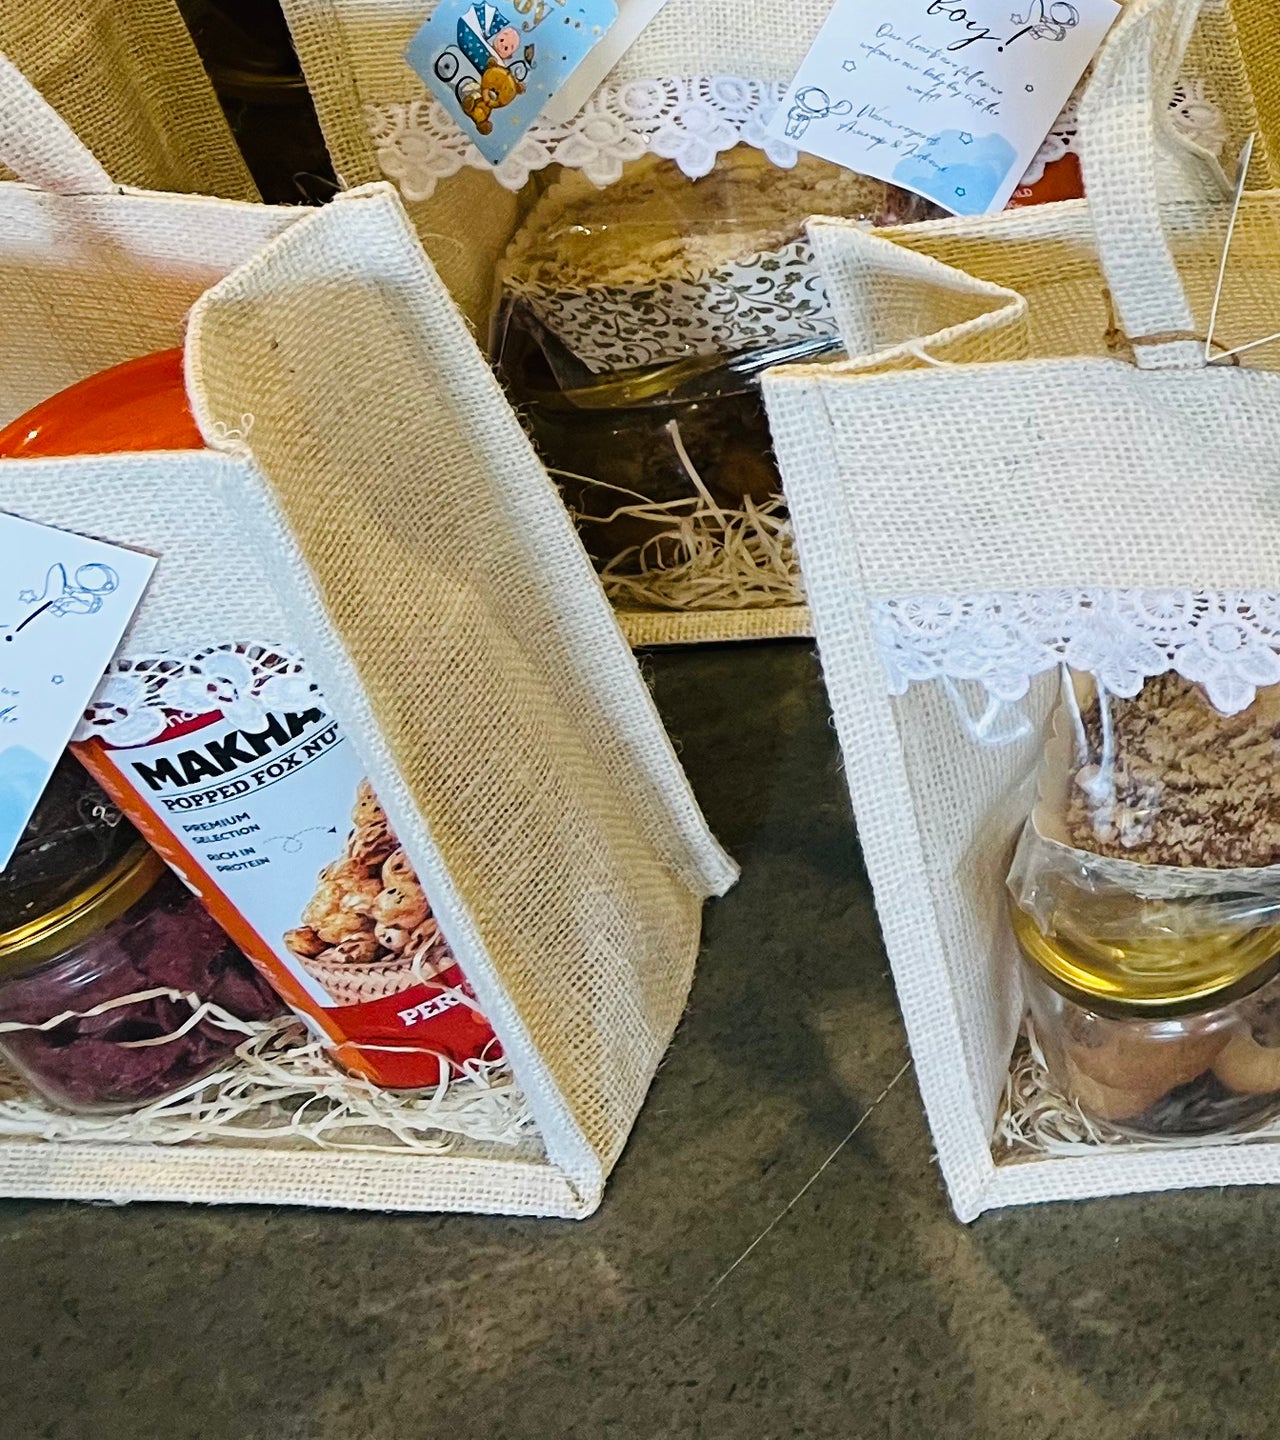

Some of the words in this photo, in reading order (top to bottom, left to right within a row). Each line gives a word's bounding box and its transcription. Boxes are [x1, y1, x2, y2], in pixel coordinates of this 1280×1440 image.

[161, 780, 251, 812] POPPED
[254, 755, 302, 788] FOX
[304, 723, 341, 760] NU
[182, 812, 251, 833] PREMIUM
[191, 824, 261, 845] SELECTION
[206, 849, 237, 863] RICH
[239, 847, 255, 858] IN
[215, 856, 270, 874] PROTEIN
